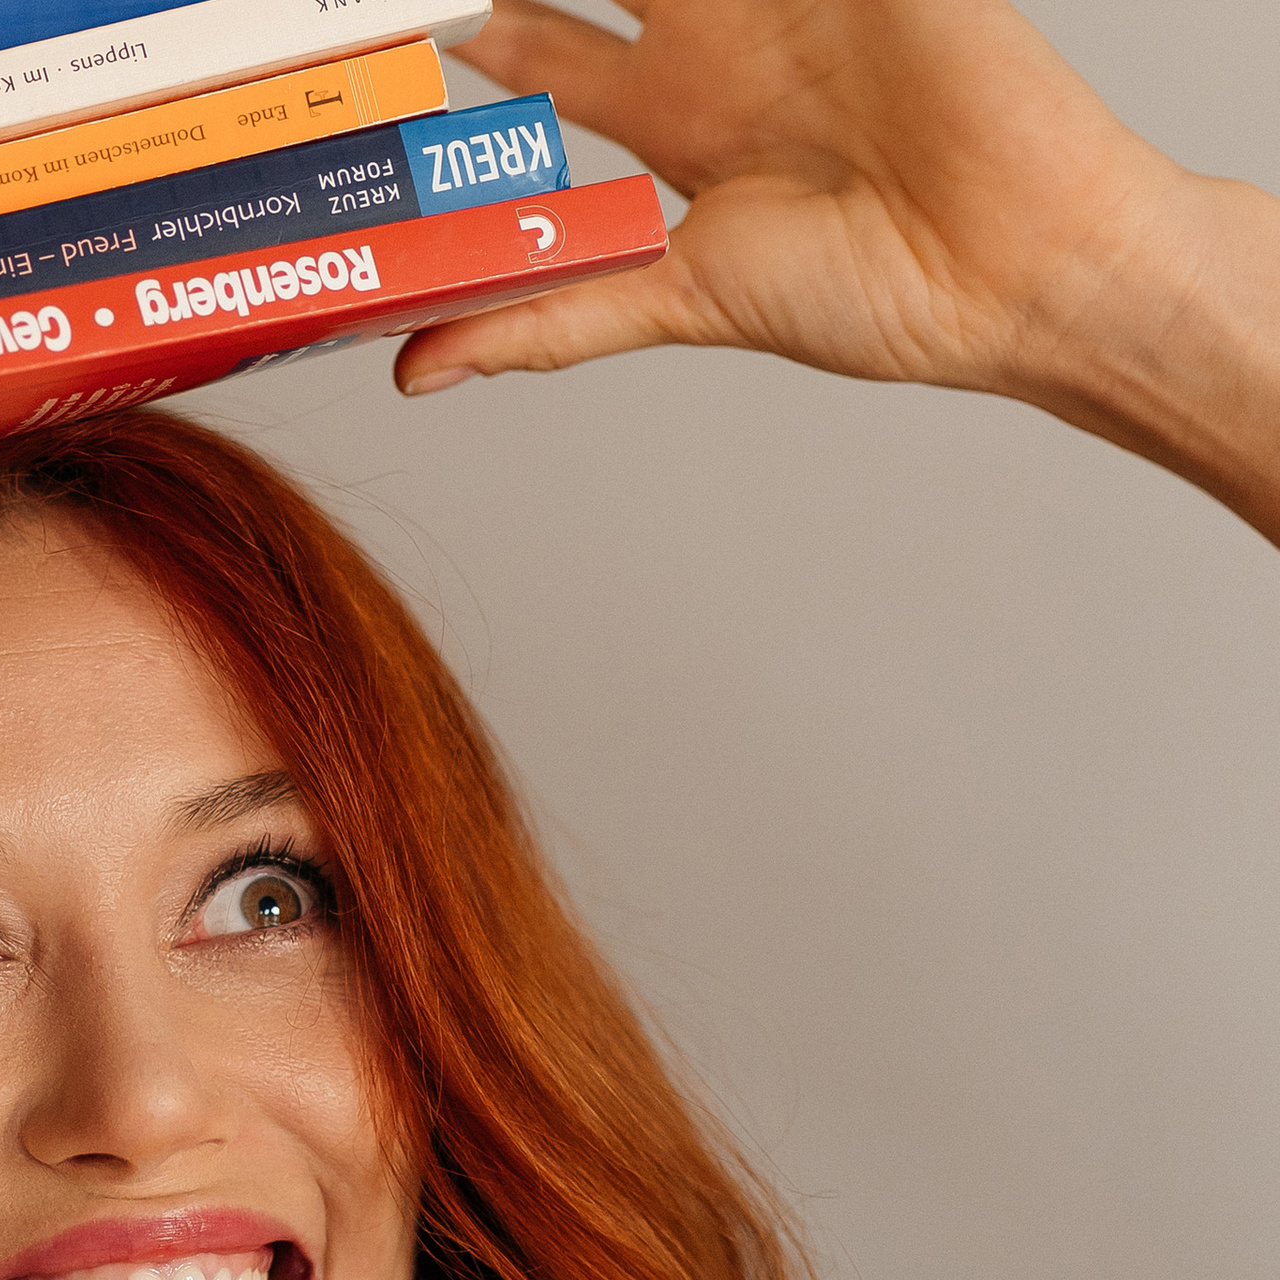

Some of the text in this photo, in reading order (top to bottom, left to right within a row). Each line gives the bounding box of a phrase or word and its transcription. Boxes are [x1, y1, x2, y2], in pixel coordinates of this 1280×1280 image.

[70, 40, 148, 73] Lippens
[23, 66, 49, 85] Im
[237, 102, 289, 128] Ende
[84, 124, 207, 168] Dolmetschen
[422, 121, 554, 193] KREUZ
[43, 155, 70, 176] im
[318, 158, 394, 189] FORUM
[328, 184, 402, 216] KREUZ
[151, 191, 302, 243] Kornbichler
[60, 229, 138, 270] Freud
[134, 244, 382, 327] Rosenberg
